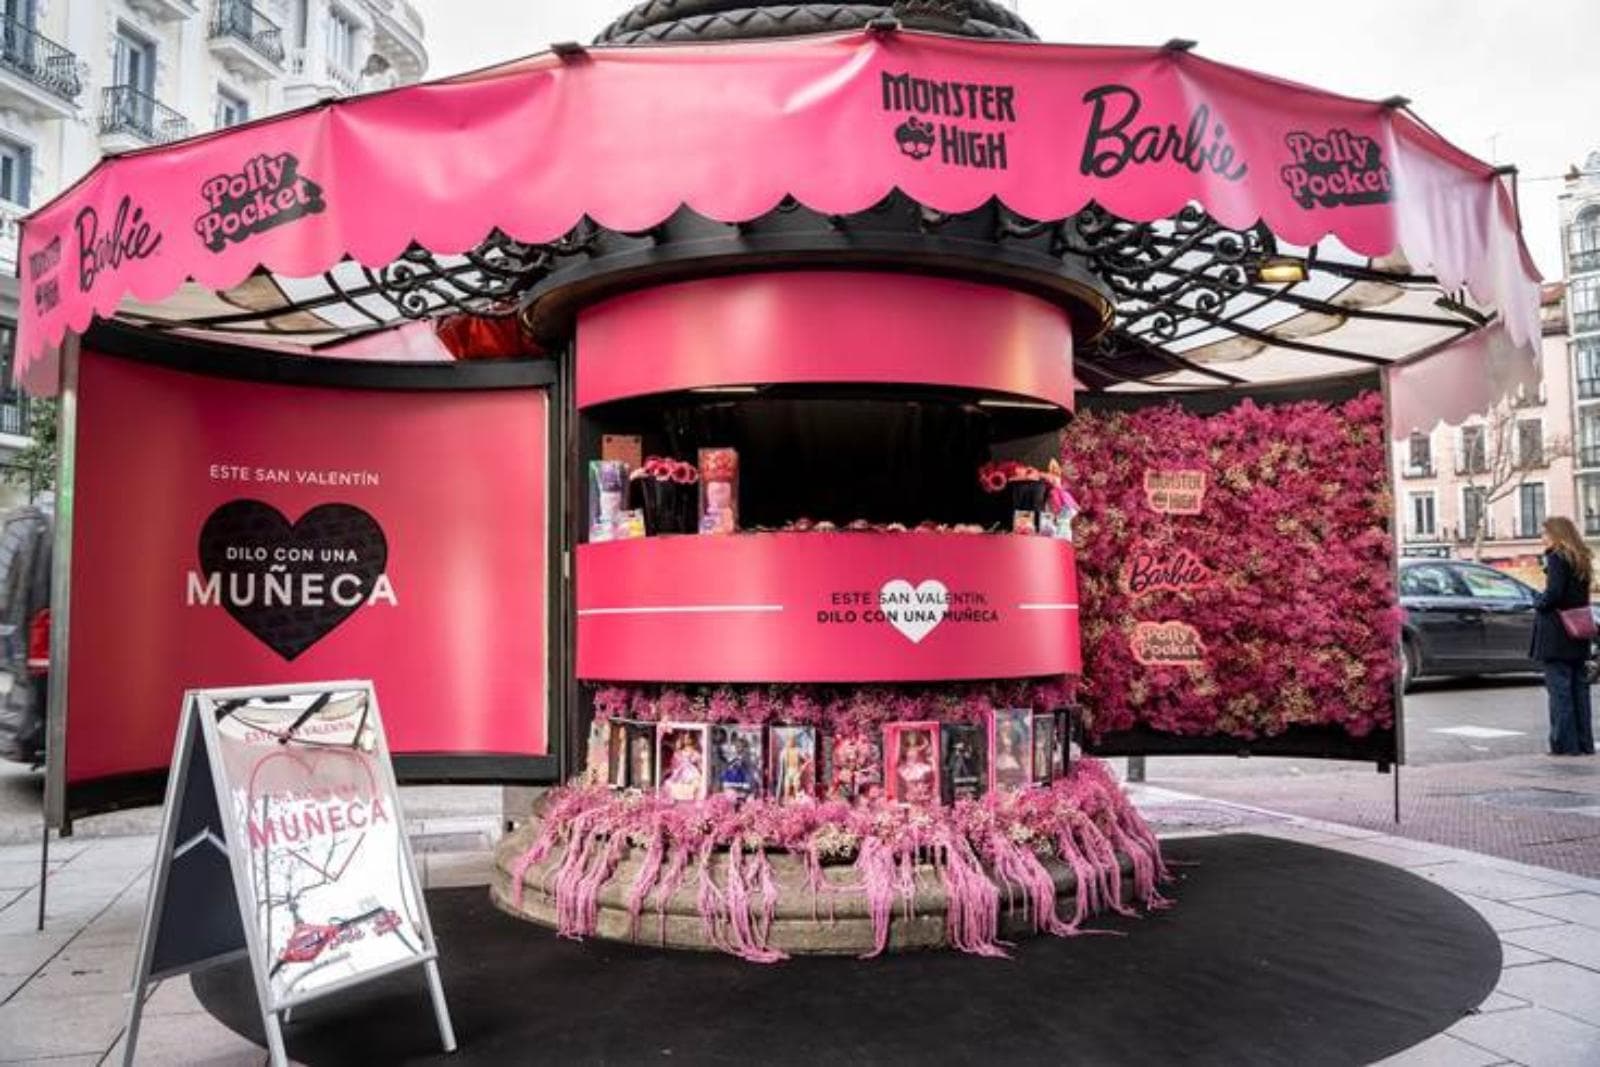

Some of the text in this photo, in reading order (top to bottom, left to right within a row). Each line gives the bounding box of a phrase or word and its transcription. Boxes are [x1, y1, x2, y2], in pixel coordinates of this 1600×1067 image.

[881, 71, 1016, 122] MONSTER
[941, 124, 1008, 170] HIGH
[1079, 84, 1248, 183] Barbie
[1284, 128, 1383, 170] Polly
[202, 152, 300, 208] Polly
[1281, 164, 1392, 209] Pocket
[195, 177, 327, 253] Pocket
[74, 195, 163, 293] Barbie
[209, 464, 380, 486] ESTE SAN VALENTÍN
[226, 547, 358, 562] DILO CON UNA
[1129, 553, 1205, 592] Barbie
[186, 564, 398, 607] MUÑECA
[831, 593, 871, 605] ESTE
[877, 593, 910, 606] SAN
[816, 607, 999, 624] DILO CON UNA MUÑECA
[248, 798, 389, 850] MUÑECA
